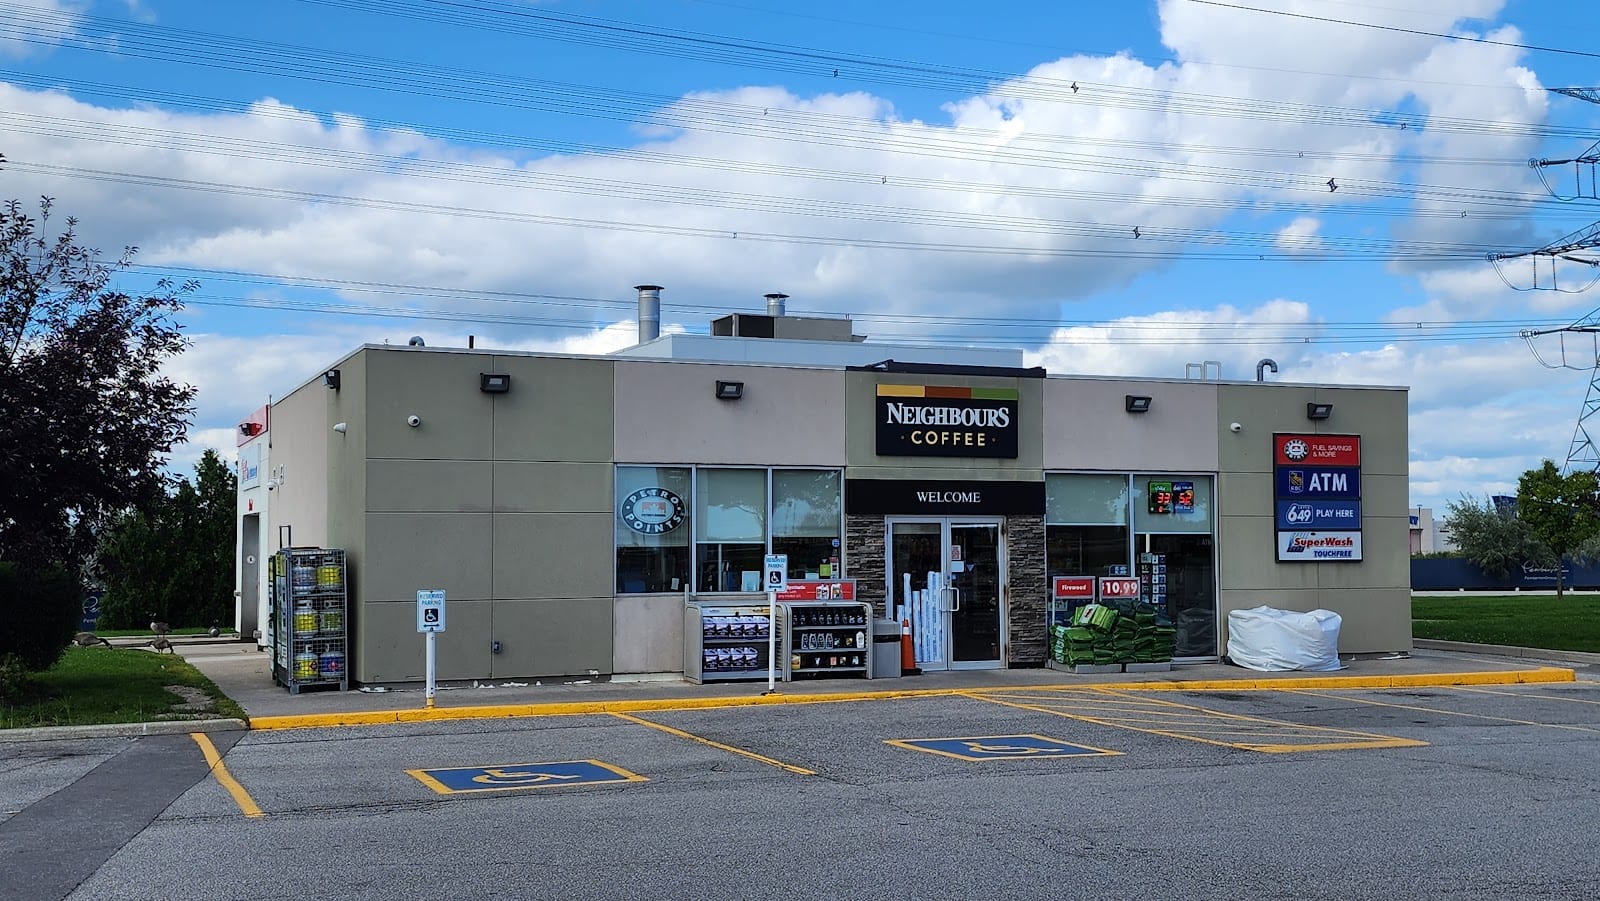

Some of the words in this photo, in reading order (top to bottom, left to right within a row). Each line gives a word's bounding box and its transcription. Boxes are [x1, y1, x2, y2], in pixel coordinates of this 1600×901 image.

[886, 402, 1010, 428] NEIGHBOURS
[911, 430, 986, 447] COFFEE
[1309, 473, 1348, 492] ATM
[629, 489, 679, 504] PETRO
[916, 491, 981, 503] WELCOME
[1288, 505, 1311, 521] 649
[1316, 509, 1333, 518] PLAY
[1335, 509, 1354, 518] HERE
[625, 513, 682, 533] POINTS
[1314, 550, 1352, 558] TOUCHFREE
